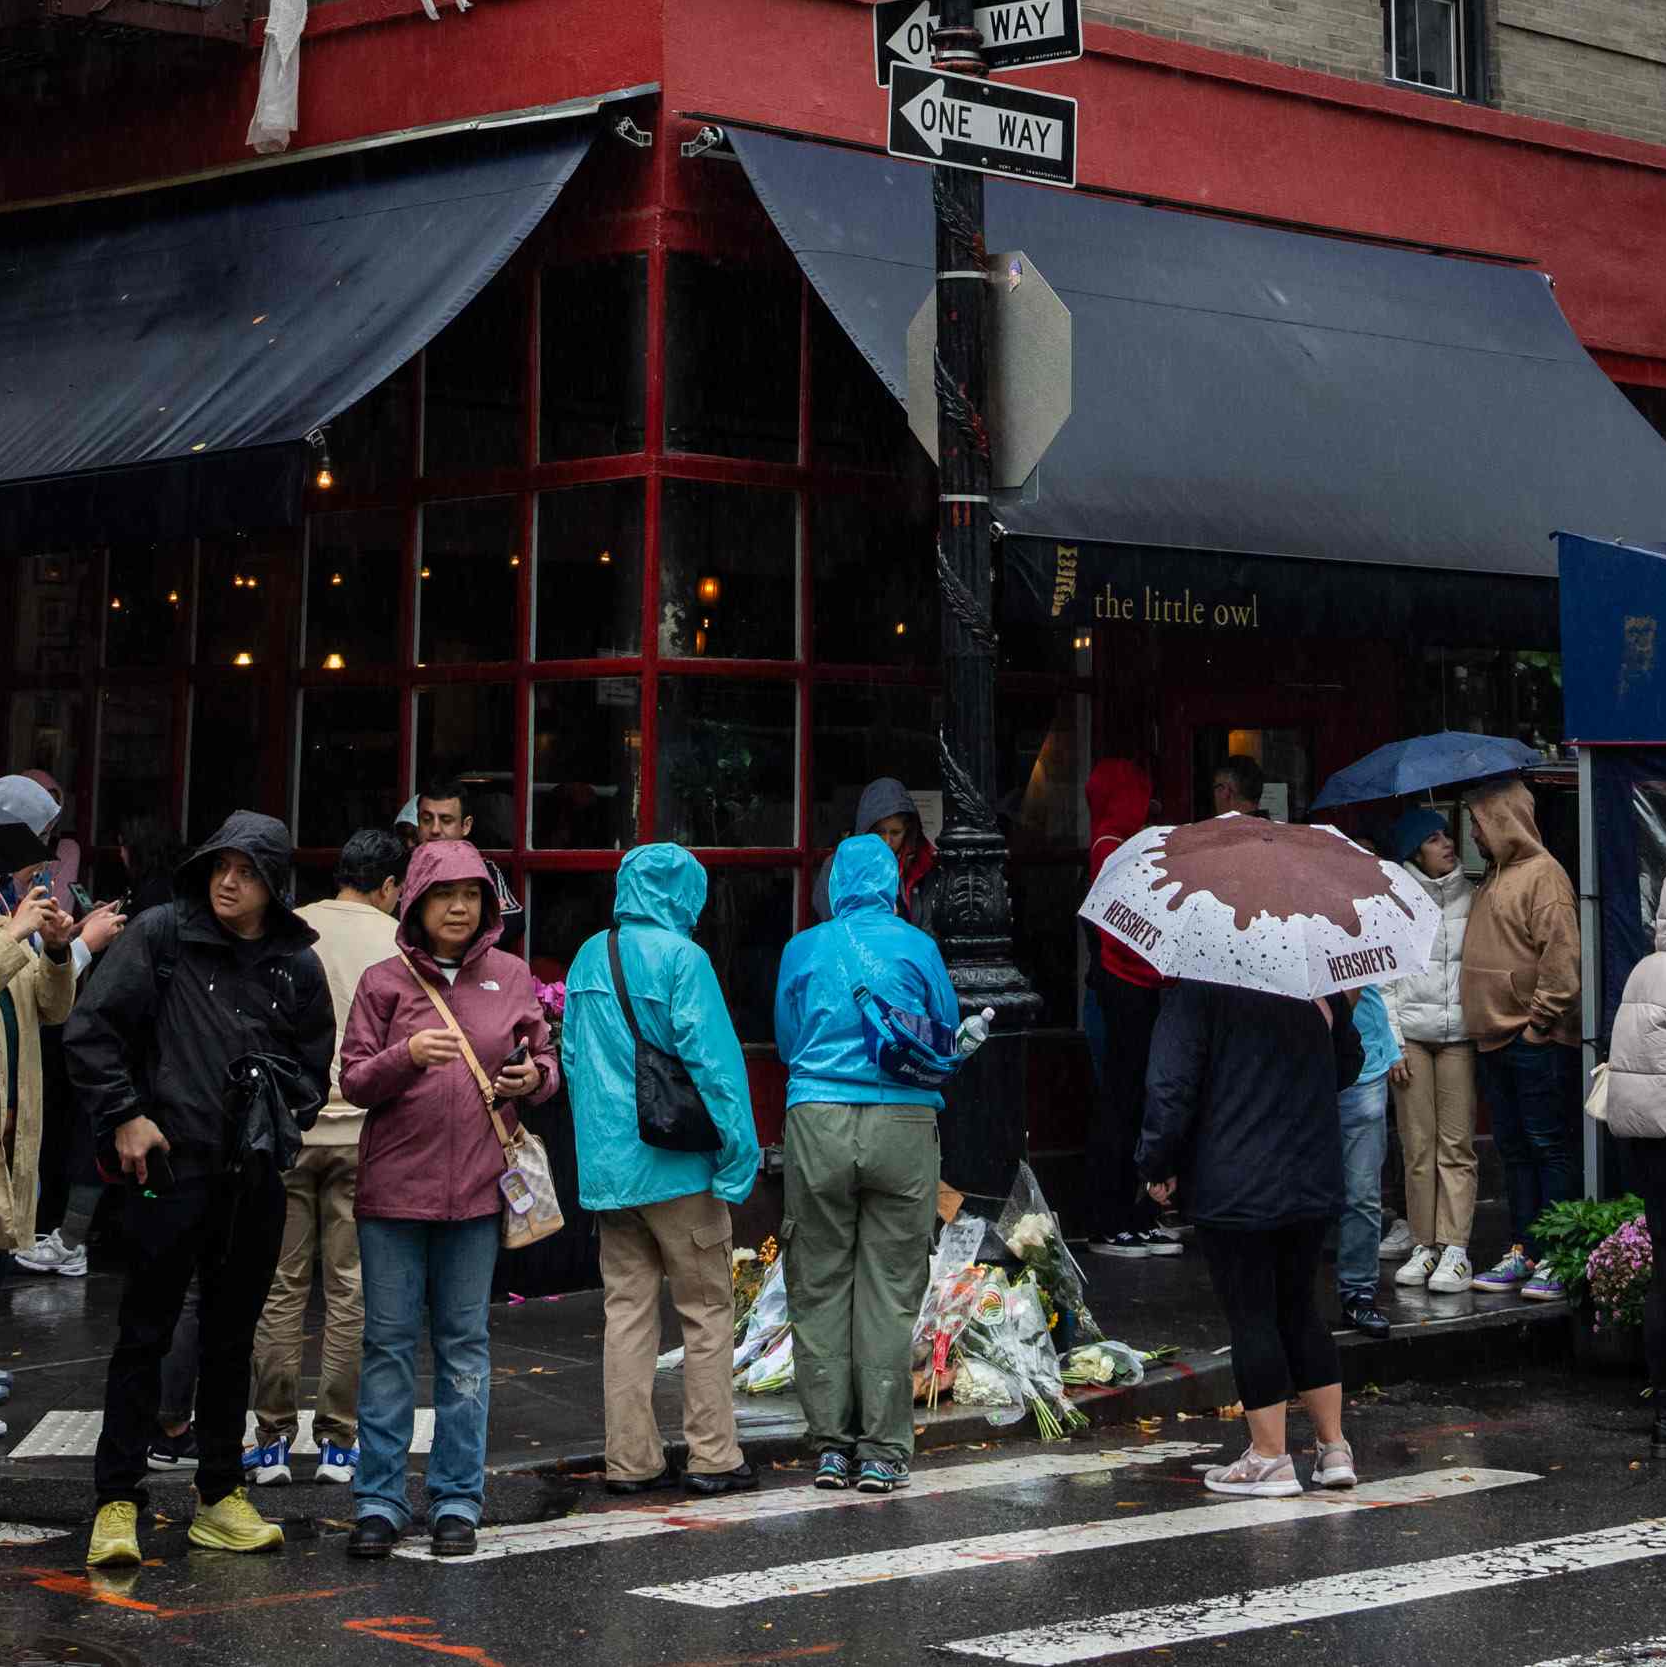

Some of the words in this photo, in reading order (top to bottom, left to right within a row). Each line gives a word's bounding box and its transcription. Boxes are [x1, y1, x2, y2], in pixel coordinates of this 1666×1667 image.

[989, 1, 1051, 43] WAY
[920, 98, 973, 140] ONE
[997, 112, 1052, 154] WAY
[1094, 583, 1133, 620] the
[1144, 585, 1205, 625] little
[1213, 593, 1260, 628] owl
[1102, 899, 1162, 951] HERSHEY'S
[1326, 945, 1398, 983] HERSHEY'S
